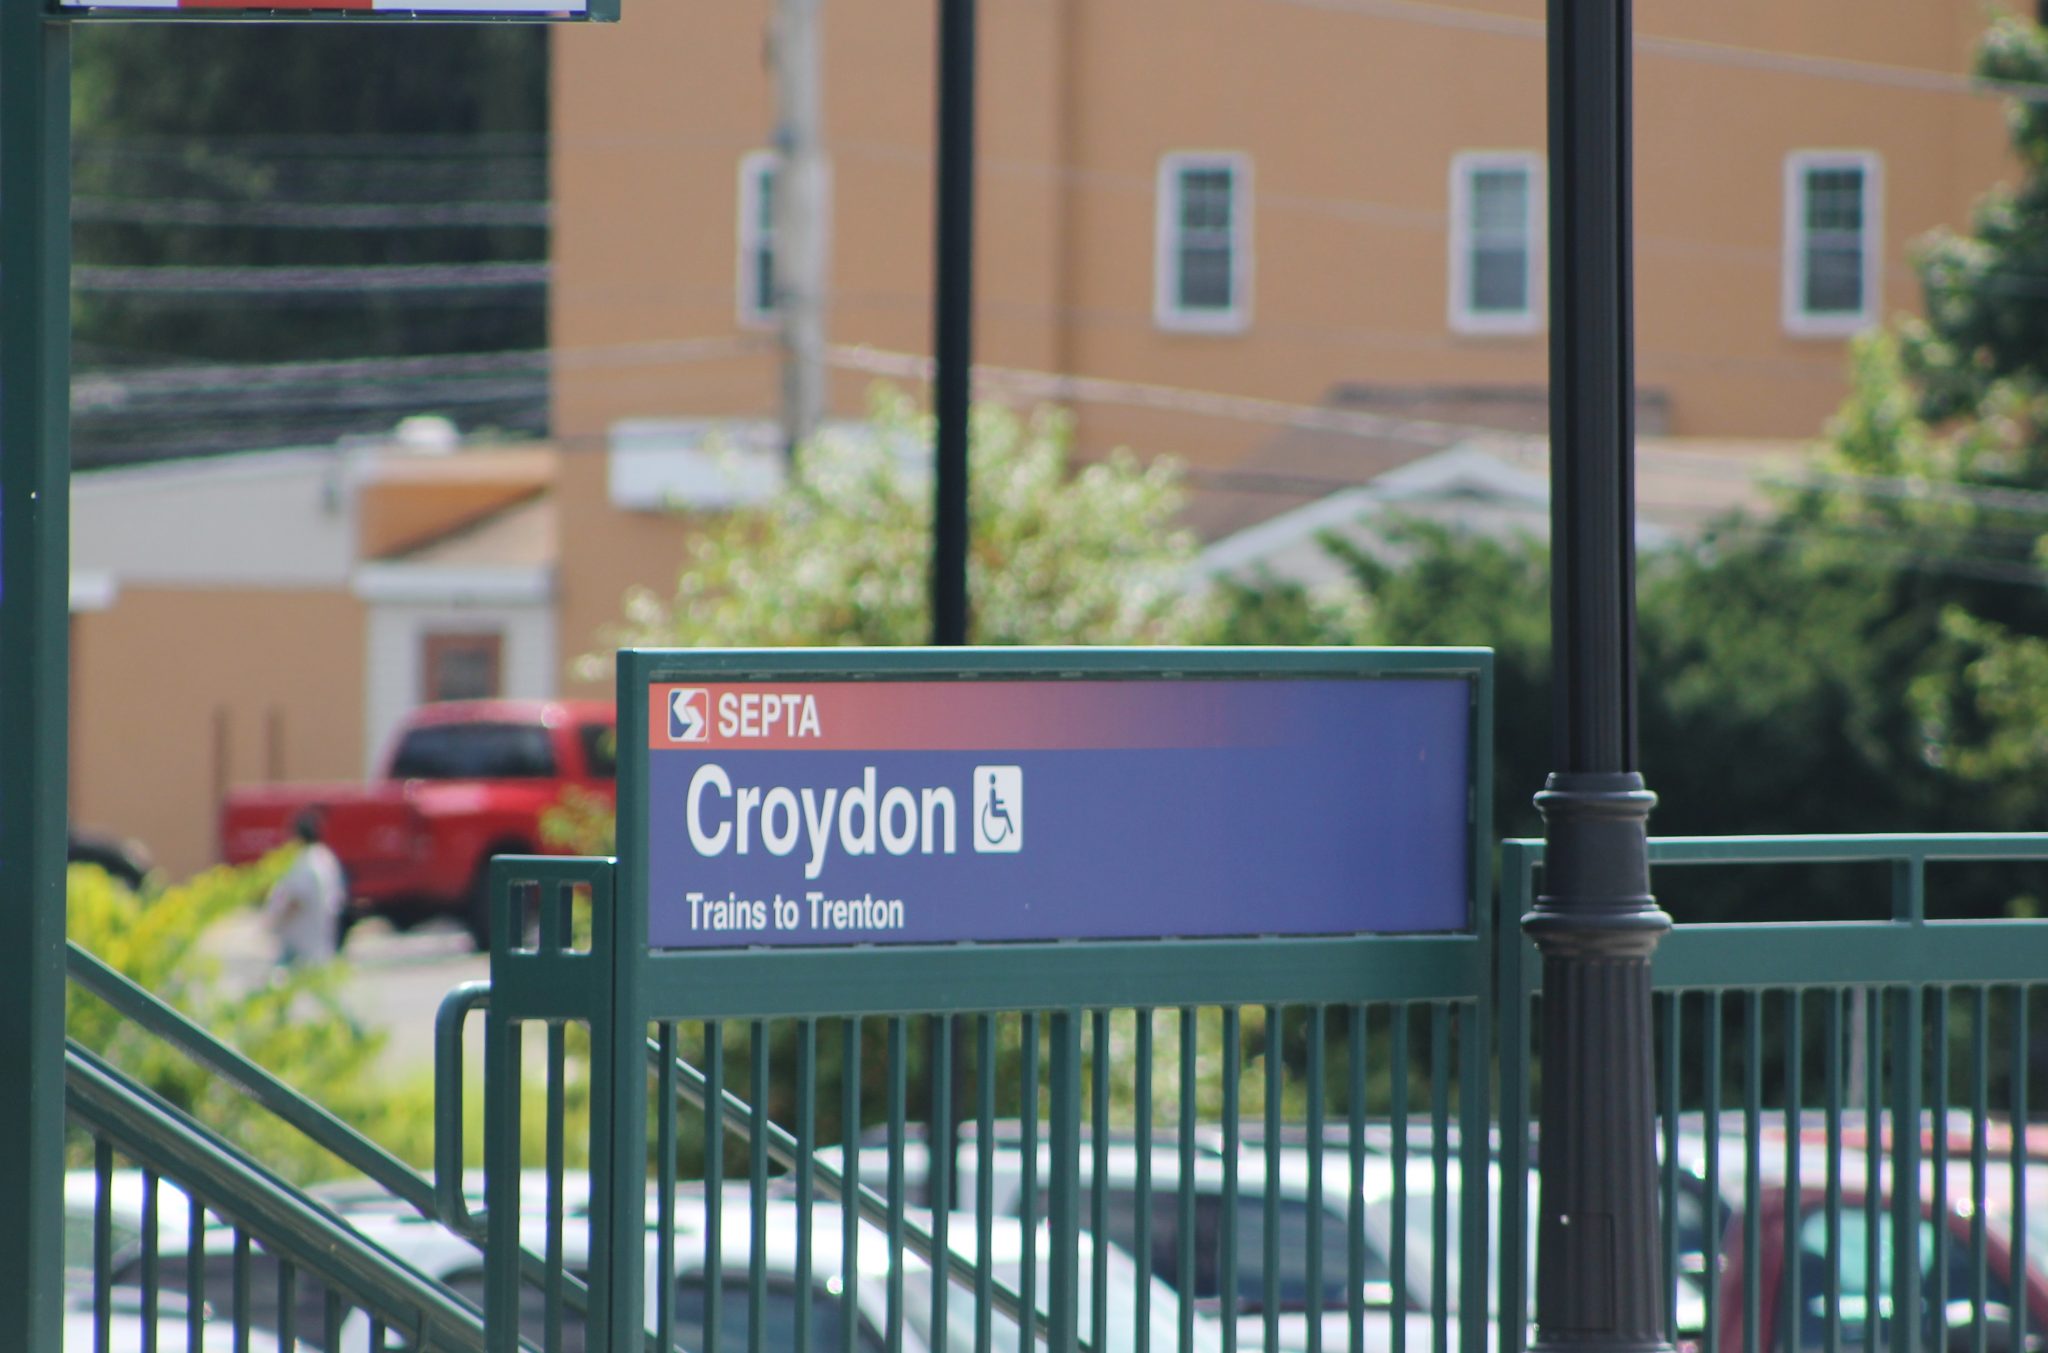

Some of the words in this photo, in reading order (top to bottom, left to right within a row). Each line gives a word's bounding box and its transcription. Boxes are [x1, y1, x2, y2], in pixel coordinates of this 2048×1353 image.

[718, 693, 821, 738] SEPTA
[686, 763, 957, 879] Croydon
[687, 892, 767, 931] Trains
[774, 894, 800, 931] to
[806, 892, 904, 931] Trenton
